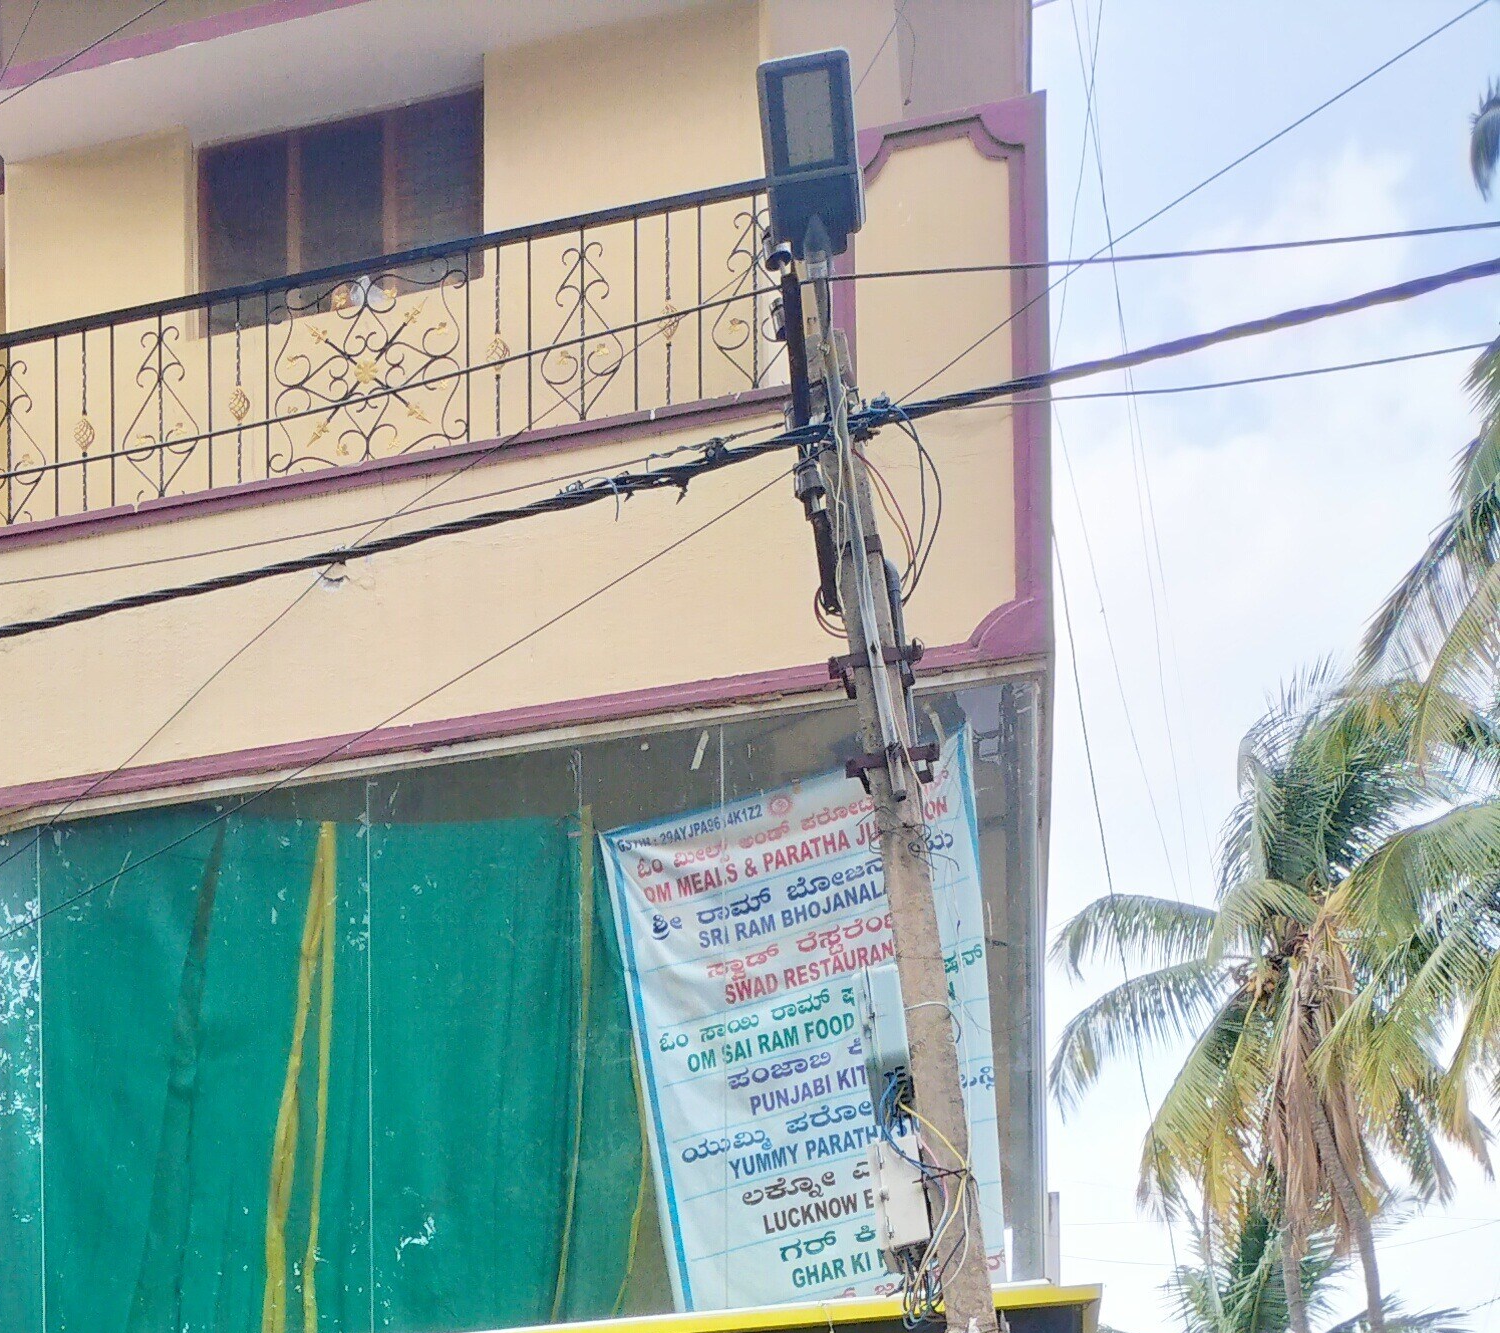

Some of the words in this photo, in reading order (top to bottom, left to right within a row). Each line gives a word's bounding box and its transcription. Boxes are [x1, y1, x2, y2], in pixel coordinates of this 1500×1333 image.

[644, 882, 672, 904] OM
[676, 863, 738, 901] MEALS
[744, 857, 758, 878] &
[762, 830, 850, 873] PARATHA
[699, 927, 730, 949] SRI
[735, 914, 776, 941] RAM
[781, 880, 888, 928] BHOJANAL
[725, 972, 779, 1005] SWAD
[783, 939, 895, 990] RESTAURAN
[687, 1049, 717, 1073] OM
[722, 1038, 753, 1064] SAI
[758, 1025, 800, 1055] RAM
[804, 1012, 855, 1043] FOOD
[750, 1074, 832, 1116] PUNJABI
[728, 1143, 799, 1180] YUMMY
[762, 1192, 859, 1235] LUCKNOW
[792, 1258, 848, 1289] GHAR
[850, 1251, 873, 1275] KI
